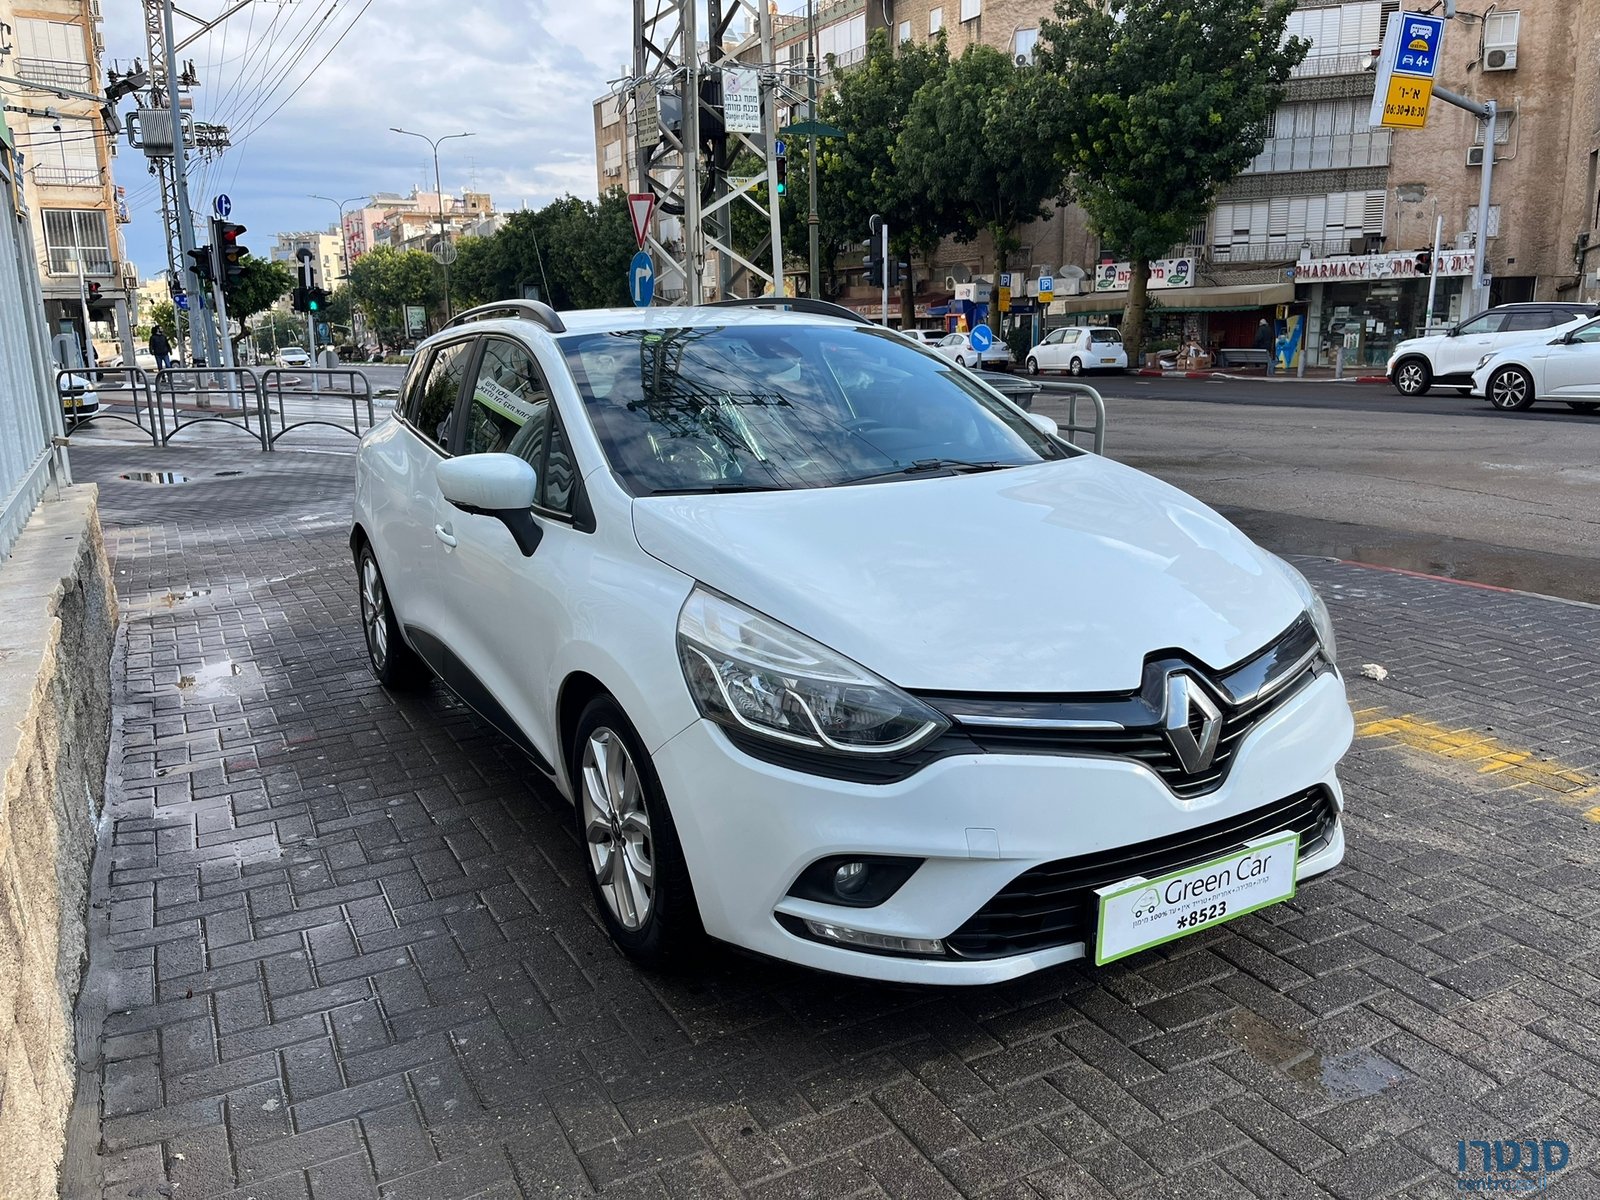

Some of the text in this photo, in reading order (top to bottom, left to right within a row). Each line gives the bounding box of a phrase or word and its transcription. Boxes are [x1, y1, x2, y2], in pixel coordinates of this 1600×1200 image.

[1416, 55, 1429, 66] 4+
[726, 112, 740, 121] Danger
[1295, 261, 1366, 279] PHARMACY
[1165, 855, 1272, 904] Green Car
[1236, 881, 1252, 892] מכירה
[1212, 889, 1232, 901] אחריות
[1182, 903, 1190, 912] אין
[1150, 910, 1168, 921] 100%
[1132, 917, 1149, 928] מימון
